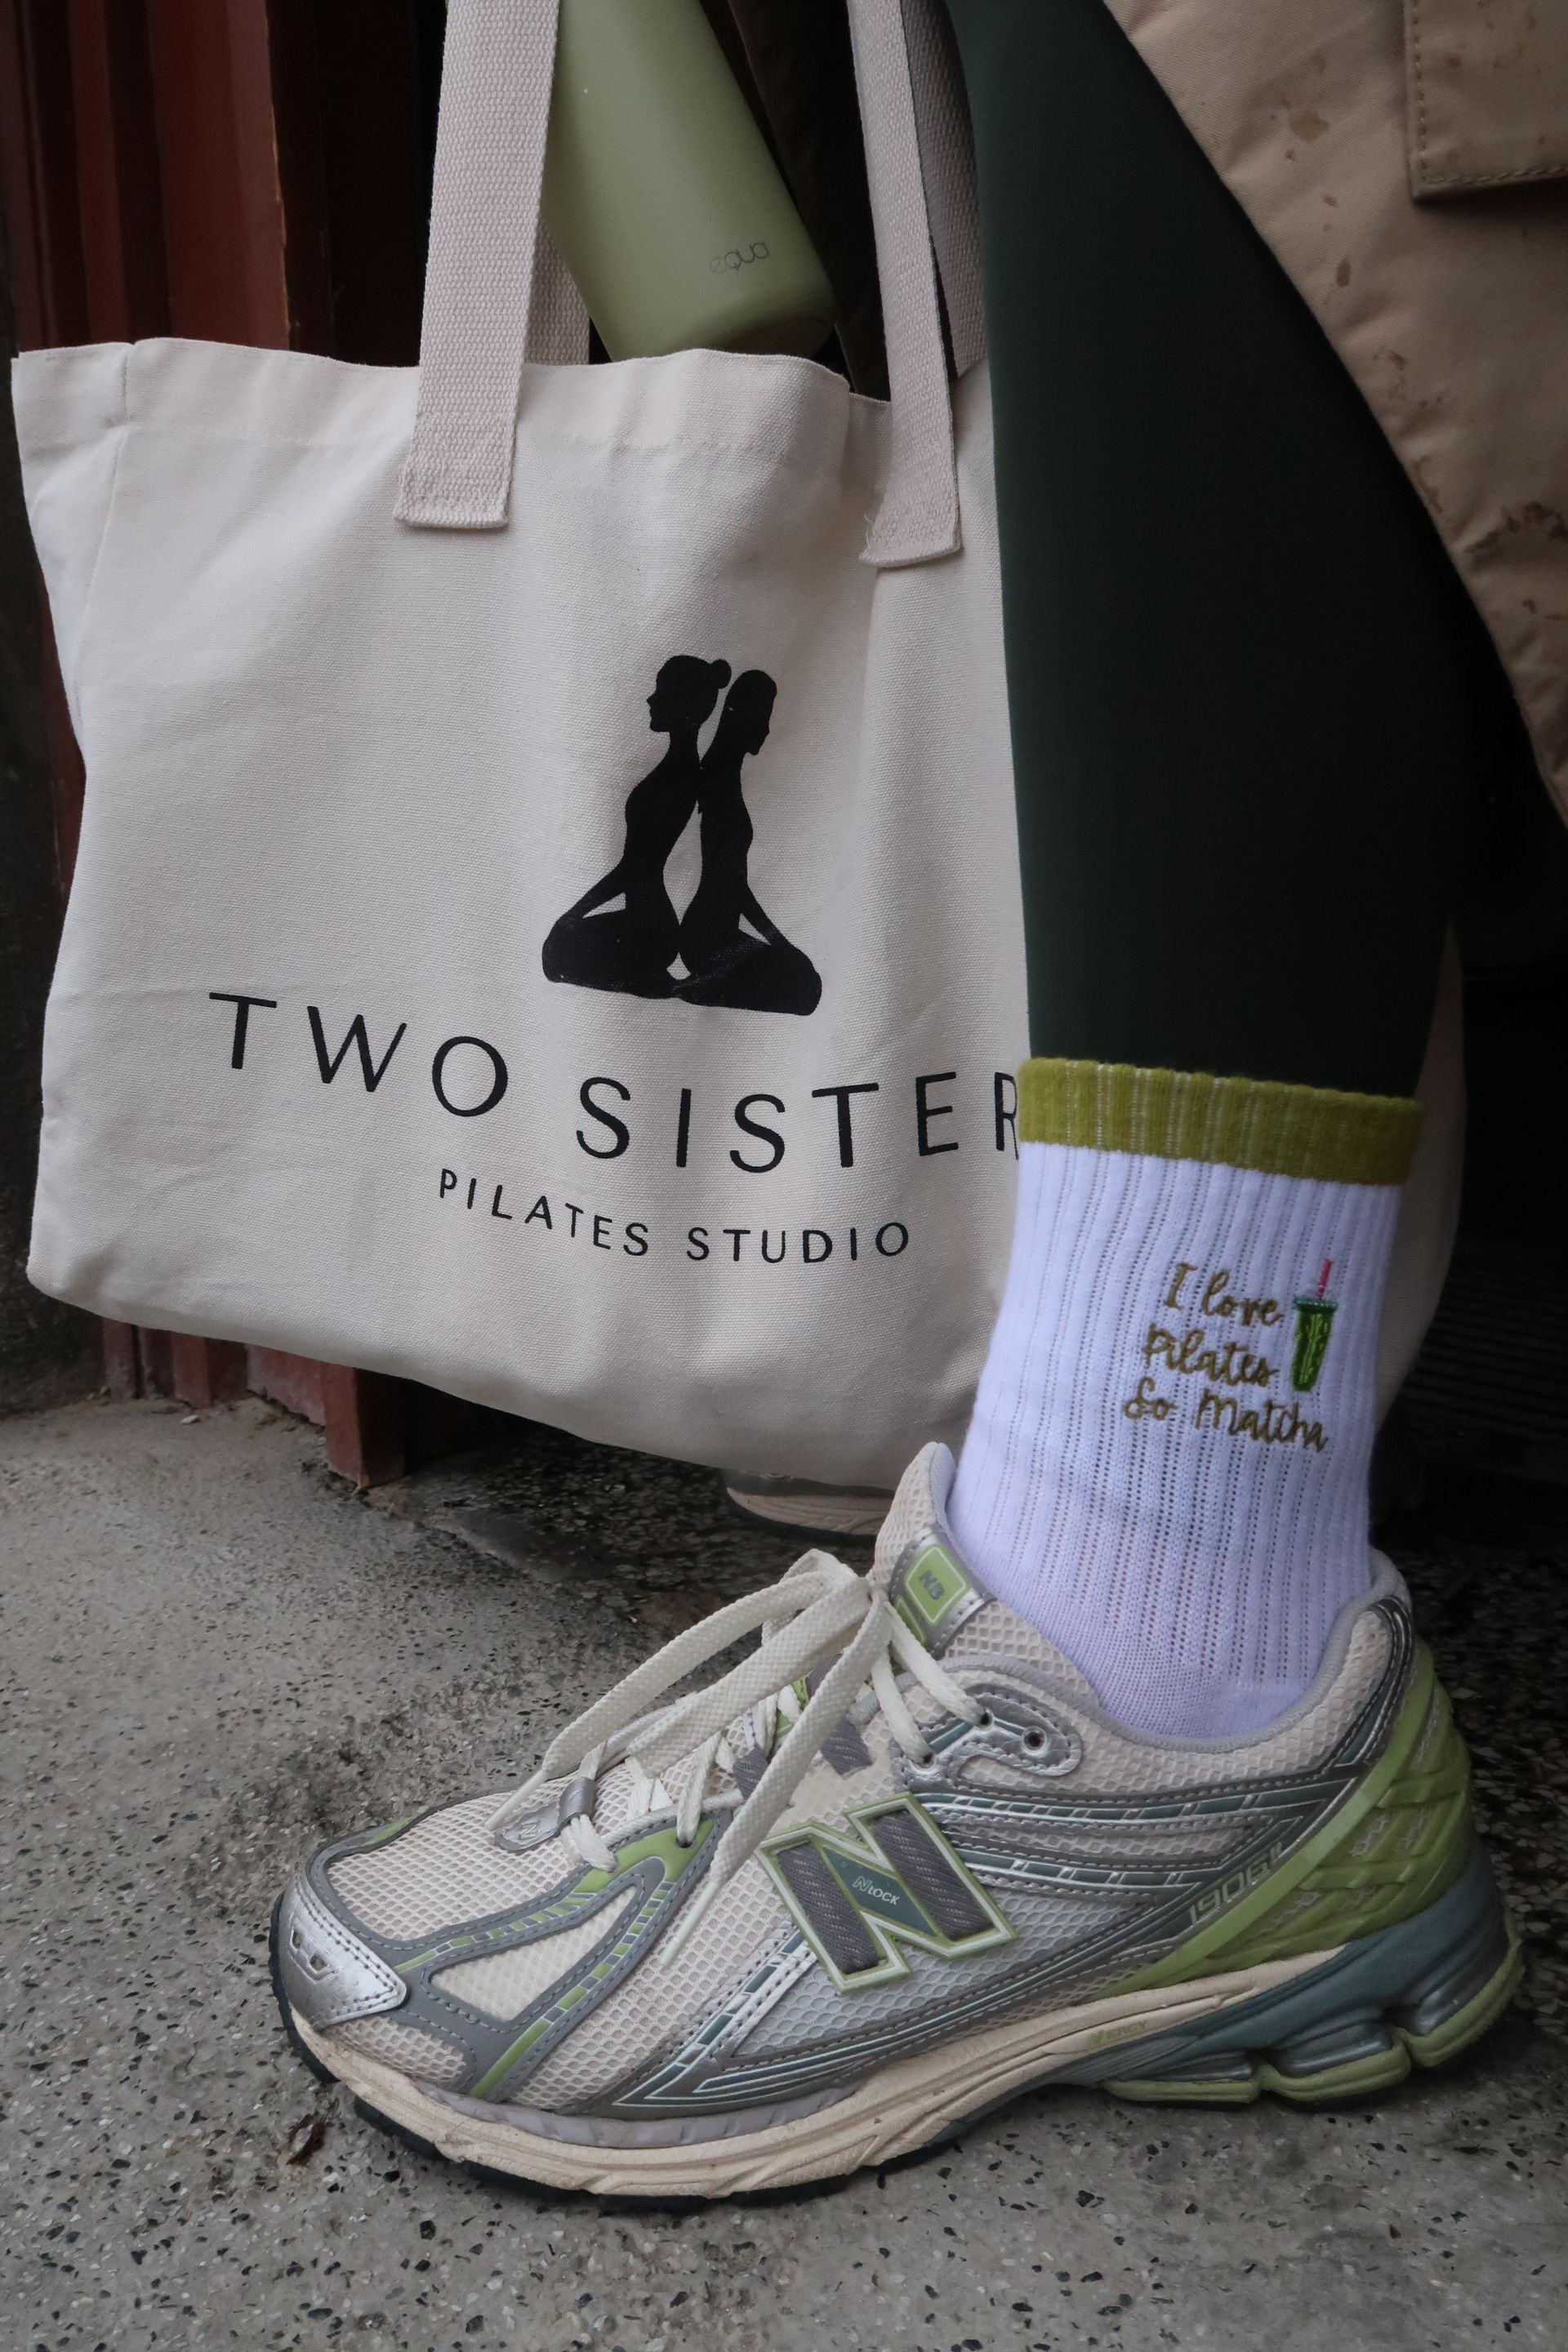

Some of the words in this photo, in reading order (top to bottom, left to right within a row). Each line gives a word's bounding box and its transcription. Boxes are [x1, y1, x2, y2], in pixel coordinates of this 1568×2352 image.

[209, 991, 509, 1117] TWO
[576, 1071, 1019, 1173] SISTER
[439, 1168, 648, 1256] PILATES
[686, 1222, 909, 1263] STUDIO
[1163, 1262, 1198, 1311] I
[1200, 1269, 1285, 1326] love
[918, 1570, 946, 1601] NB
[753, 1790, 1016, 1993] N
